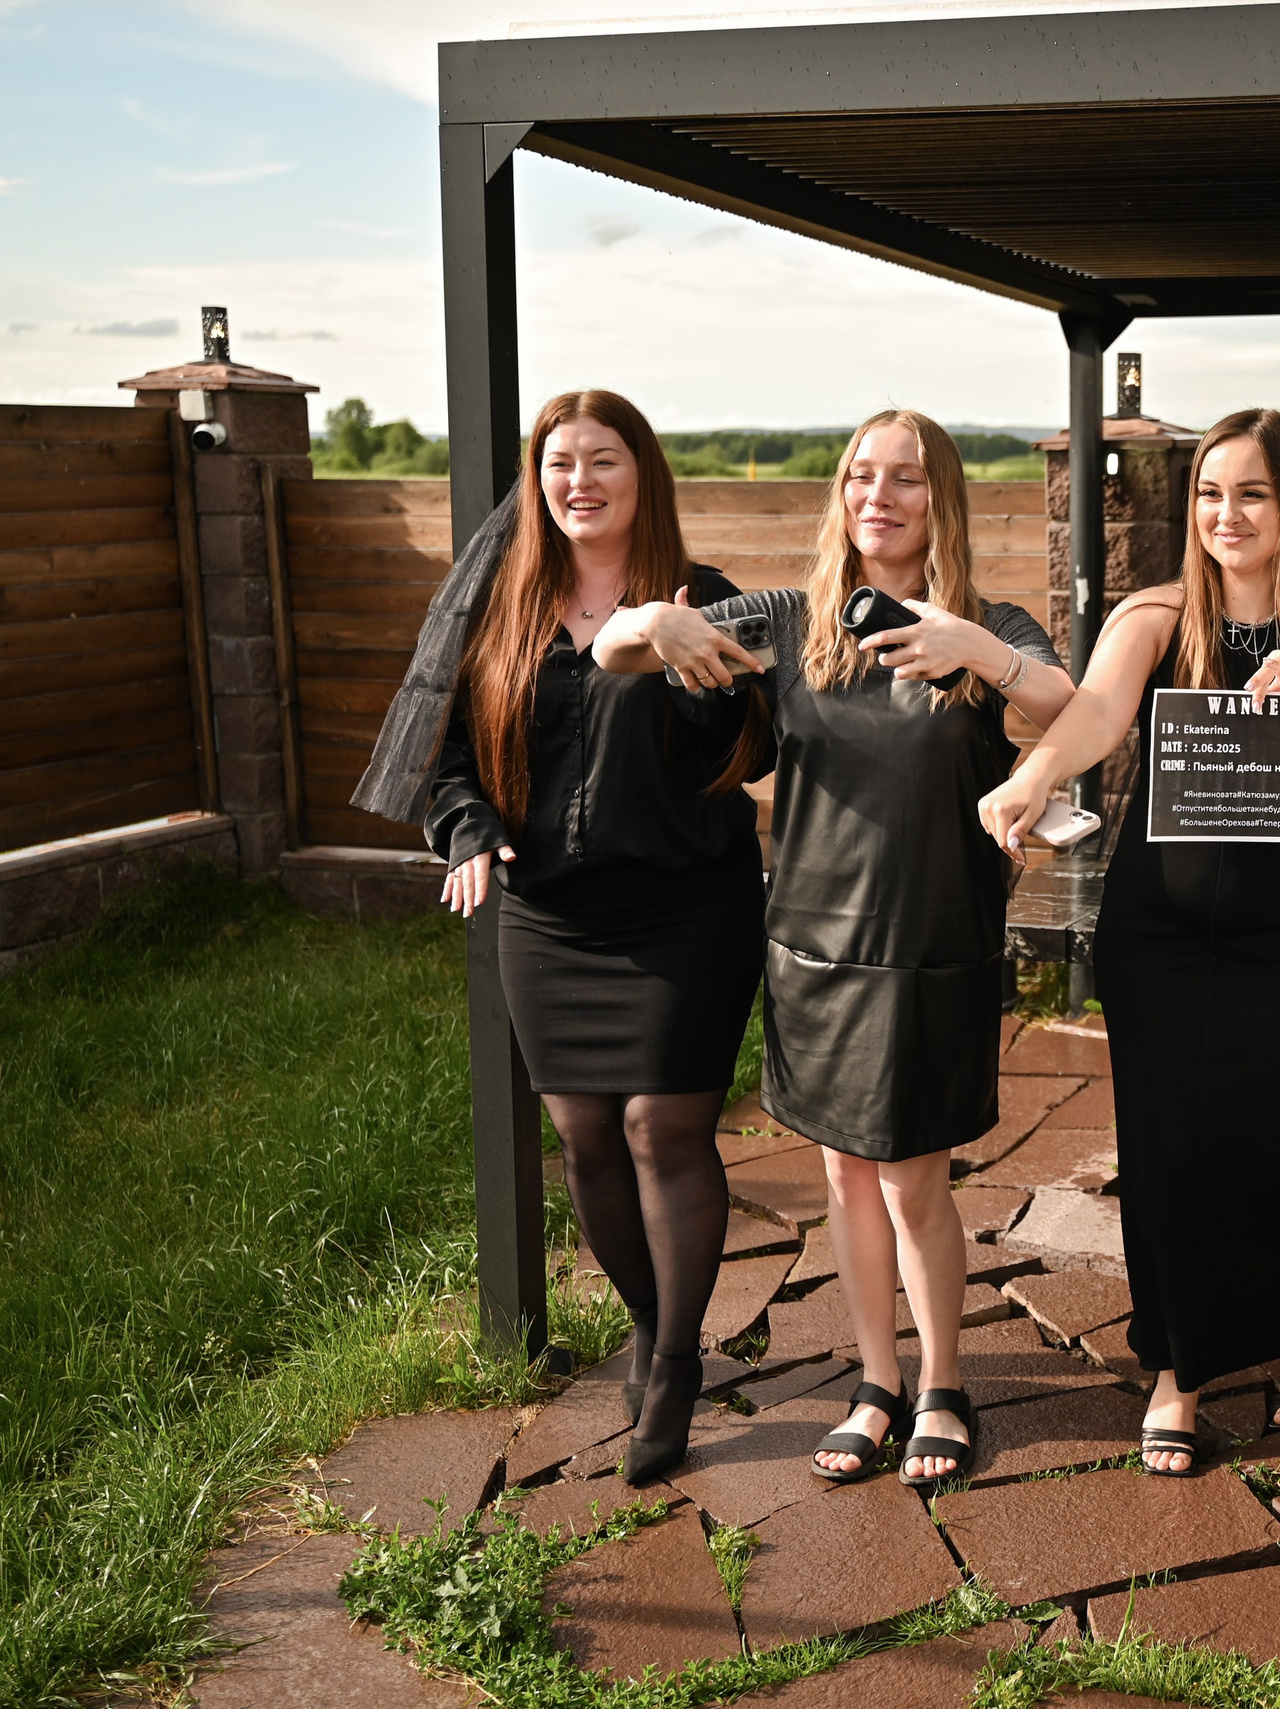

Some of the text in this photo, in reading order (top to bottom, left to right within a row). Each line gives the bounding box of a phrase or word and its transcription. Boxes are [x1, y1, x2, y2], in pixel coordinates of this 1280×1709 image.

[1183, 724, 1230, 735] Ekaterina
[1192, 743, 1241, 753] 2.06.2025
[1193, 761, 1234, 772] Пьяный
[1236, 762, 1272, 774] дебош
